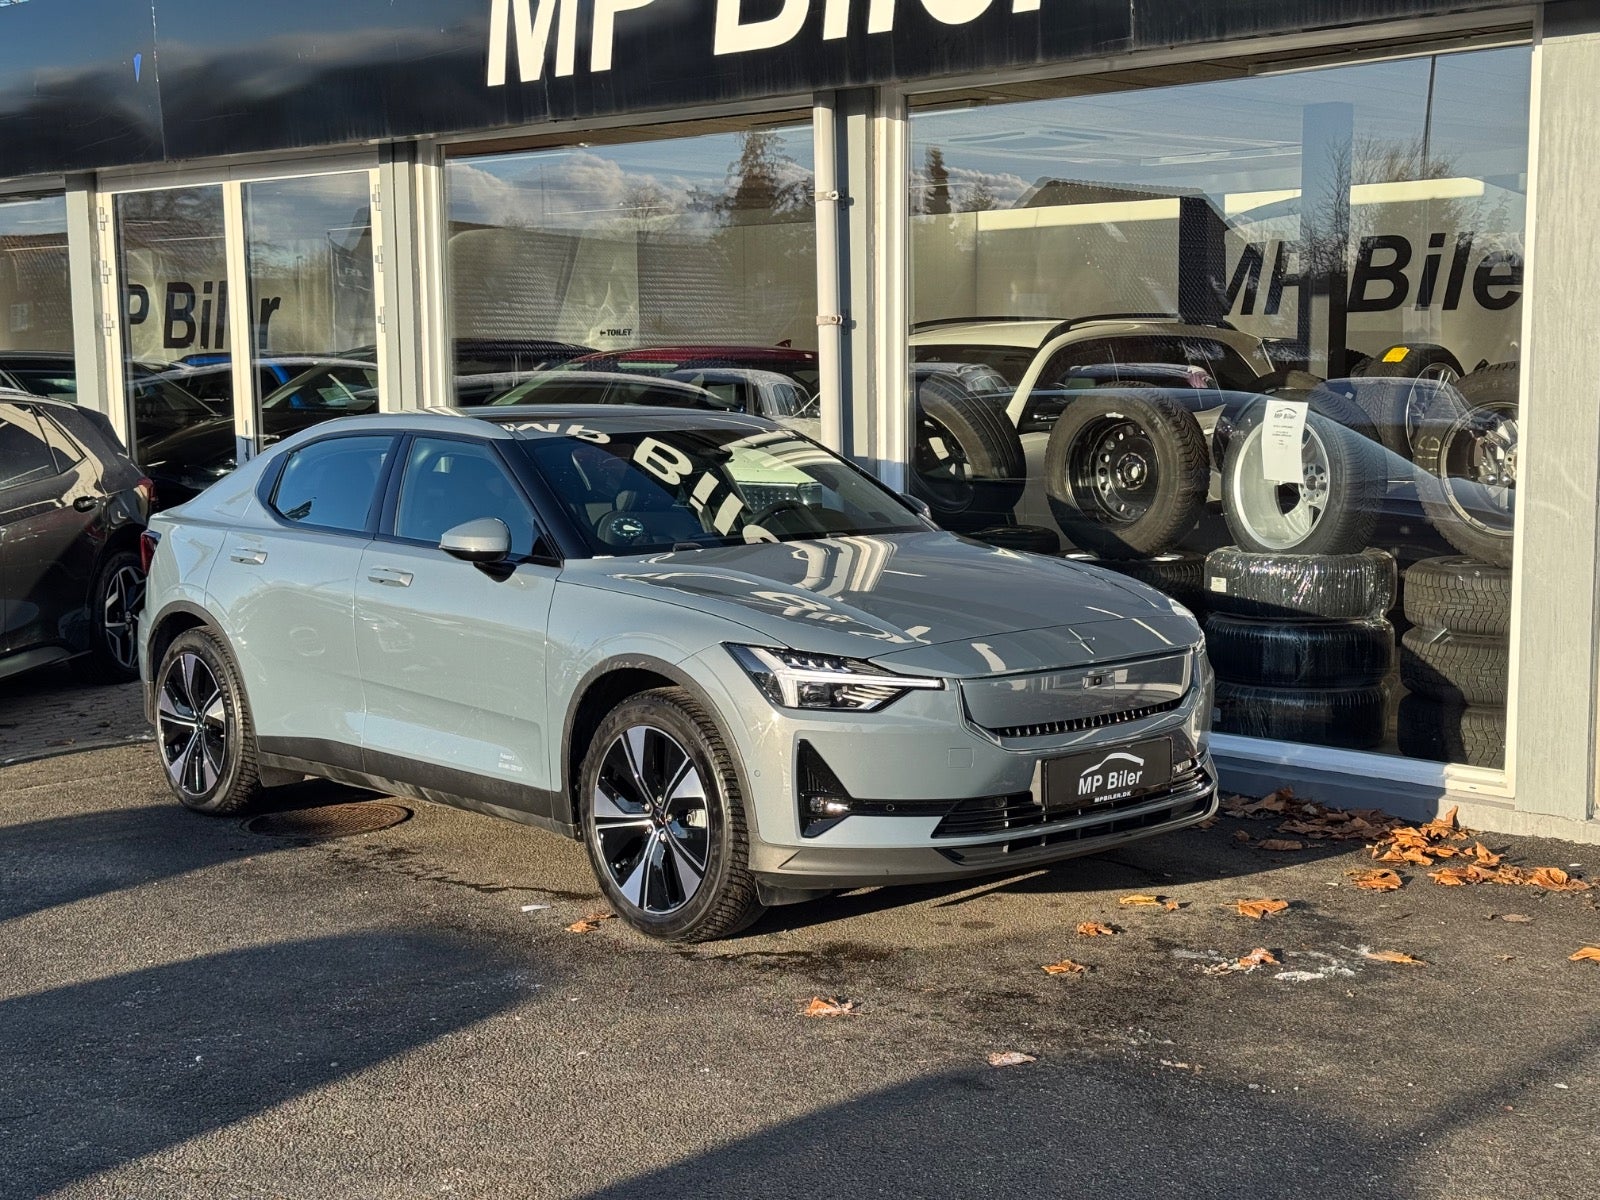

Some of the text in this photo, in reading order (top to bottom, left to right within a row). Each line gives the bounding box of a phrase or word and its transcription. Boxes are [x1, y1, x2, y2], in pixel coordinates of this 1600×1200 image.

[164, 280, 281, 350] Bilr
[606, 328, 632, 337] TOILET
[1078, 770, 1143, 795] MP Biler
[1094, 791, 1132, 803] MPBILER.DK
